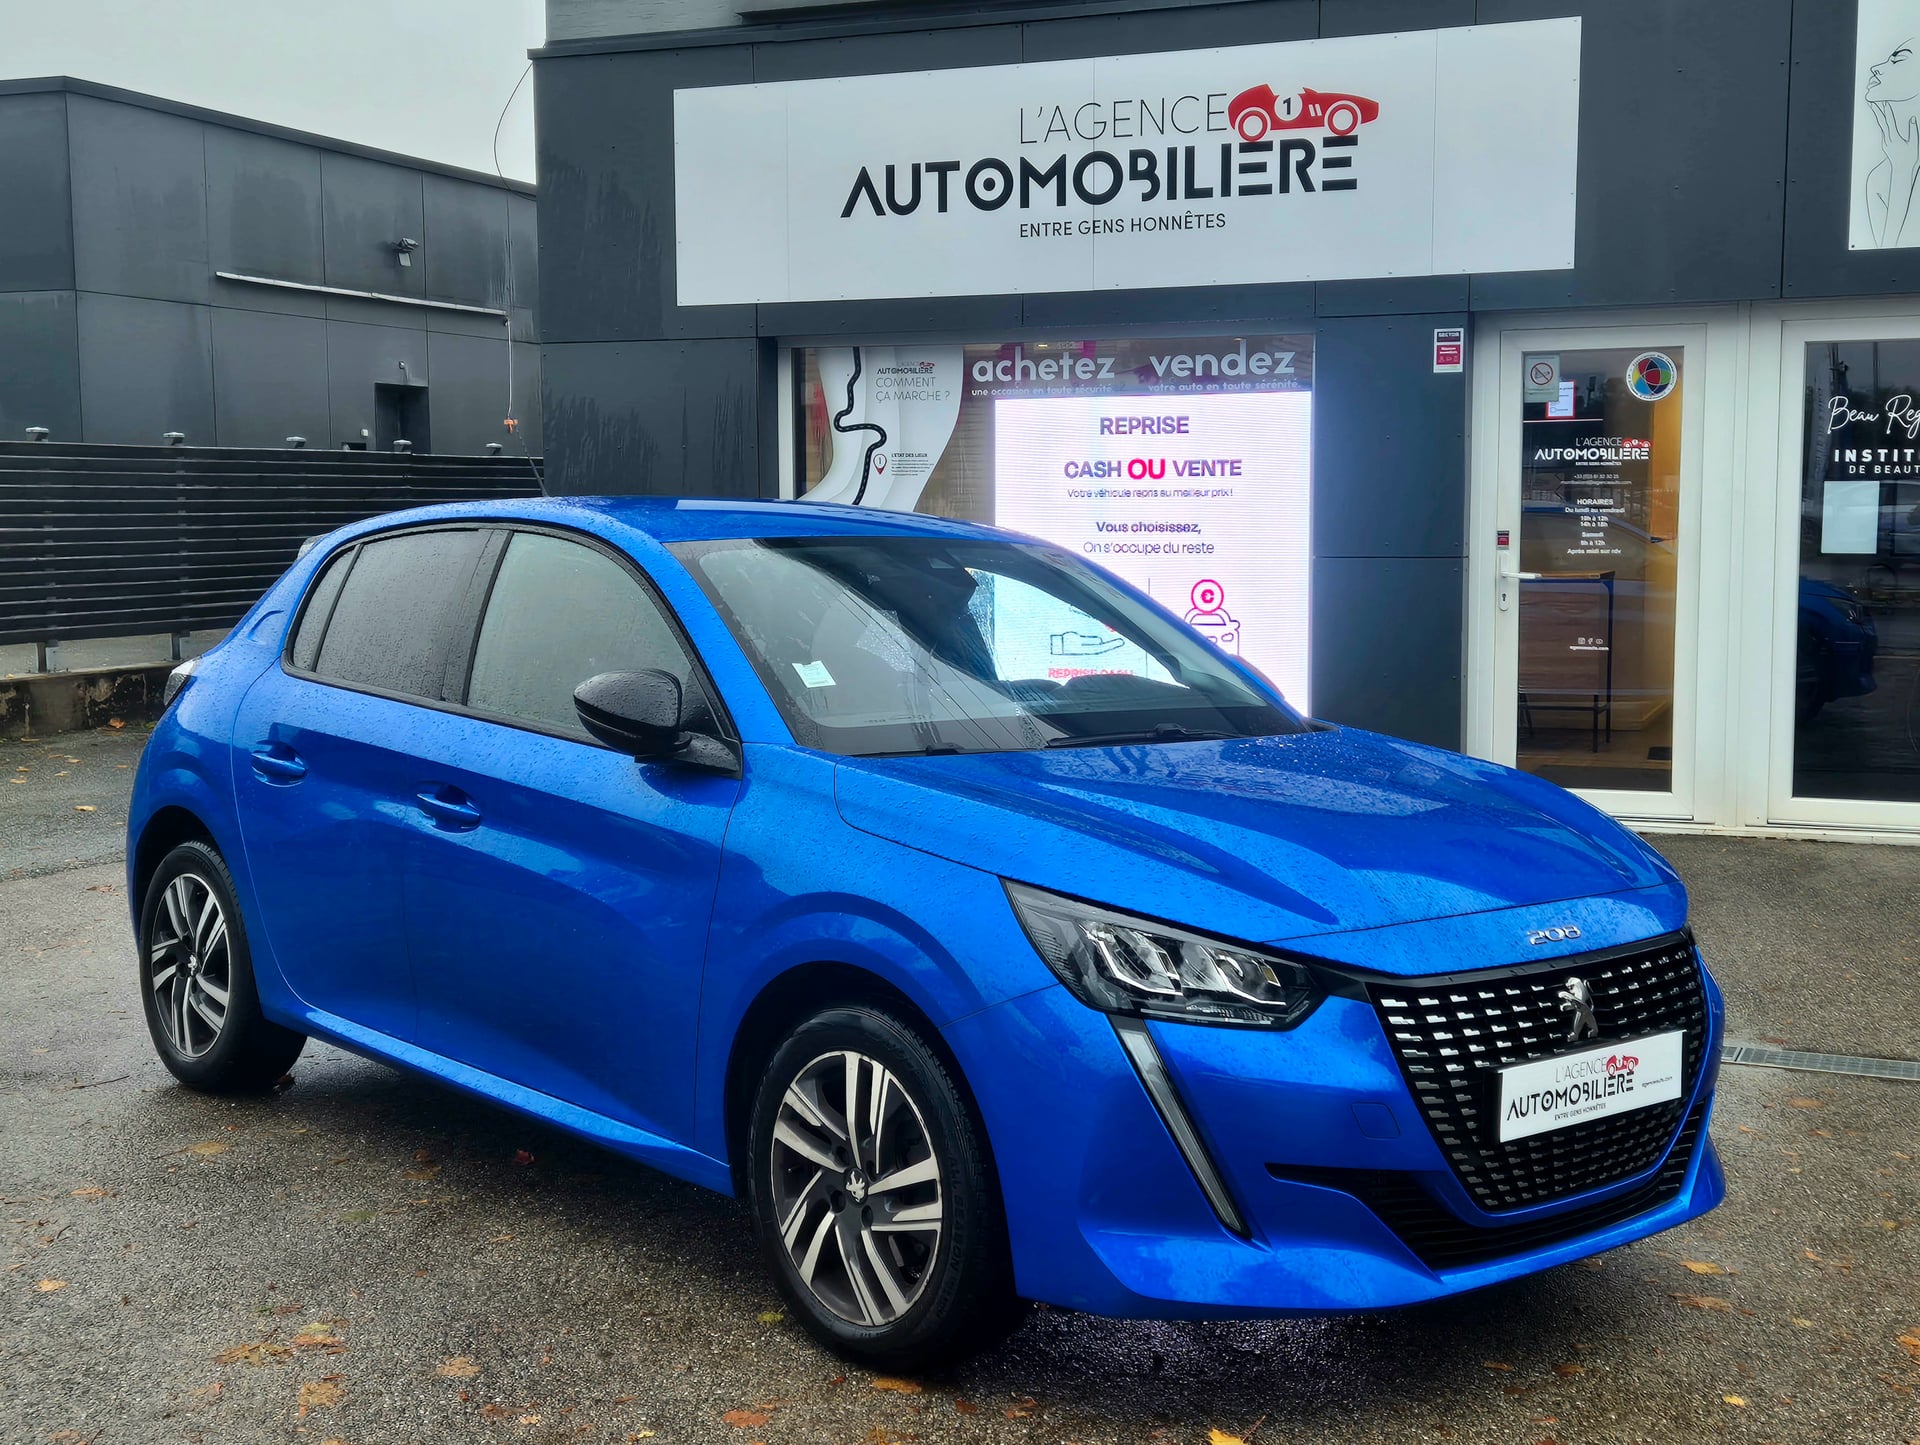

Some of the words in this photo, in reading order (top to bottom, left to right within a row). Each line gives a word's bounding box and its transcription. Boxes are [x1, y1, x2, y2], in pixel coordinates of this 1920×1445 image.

[1019, 93, 1228, 145] L'AGENCE
[1019, 219, 1072, 239] ENTRE
[1078, 217, 1125, 236] GENS
[1131, 209, 1227, 232] HONNÊTES
[972, 345, 1116, 383] achetez
[1149, 338, 1296, 377] vendez
[875, 377, 937, 388] COMMENT
[1149, 381, 1176, 392] votre
[1178, 381, 1203, 391] auto
[1206, 383, 1220, 391] en
[1222, 380, 1250, 390] toute
[875, 390, 891, 404] ÇA
[894, 390, 941, 401] MARCHE
[944, 390, 951, 401] ?
[971, 388, 988, 396] une
[991, 386, 1030, 396] occasion
[1047, 385, 1072, 394] toute
[1827, 396, 1880, 435] Beau
[1099, 416, 1190, 435] REPRISE
[1575, 436, 1623, 447] L'AGENCE
[1834, 449, 1920, 463] INSTIT
[1063, 460, 1122, 479] CASH
[1127, 457, 1166, 480] OU
[1172, 458, 1243, 477] VENTE
[1849, 465, 1866, 474] DE
[1067, 488, 1093, 498] Votre
[1094, 487, 1131, 498] véhicule
[1096, 521, 1129, 533] Vous
[1131, 521, 1201, 534] choisissez,
[1083, 541, 1102, 553] On
[1104, 541, 1161, 556] s'occupe
[1163, 541, 1180, 553] du
[1182, 541, 1215, 554] reste
[1526, 924, 1582, 945] 208
[1554, 1056, 1608, 1084] L'AGENCE
